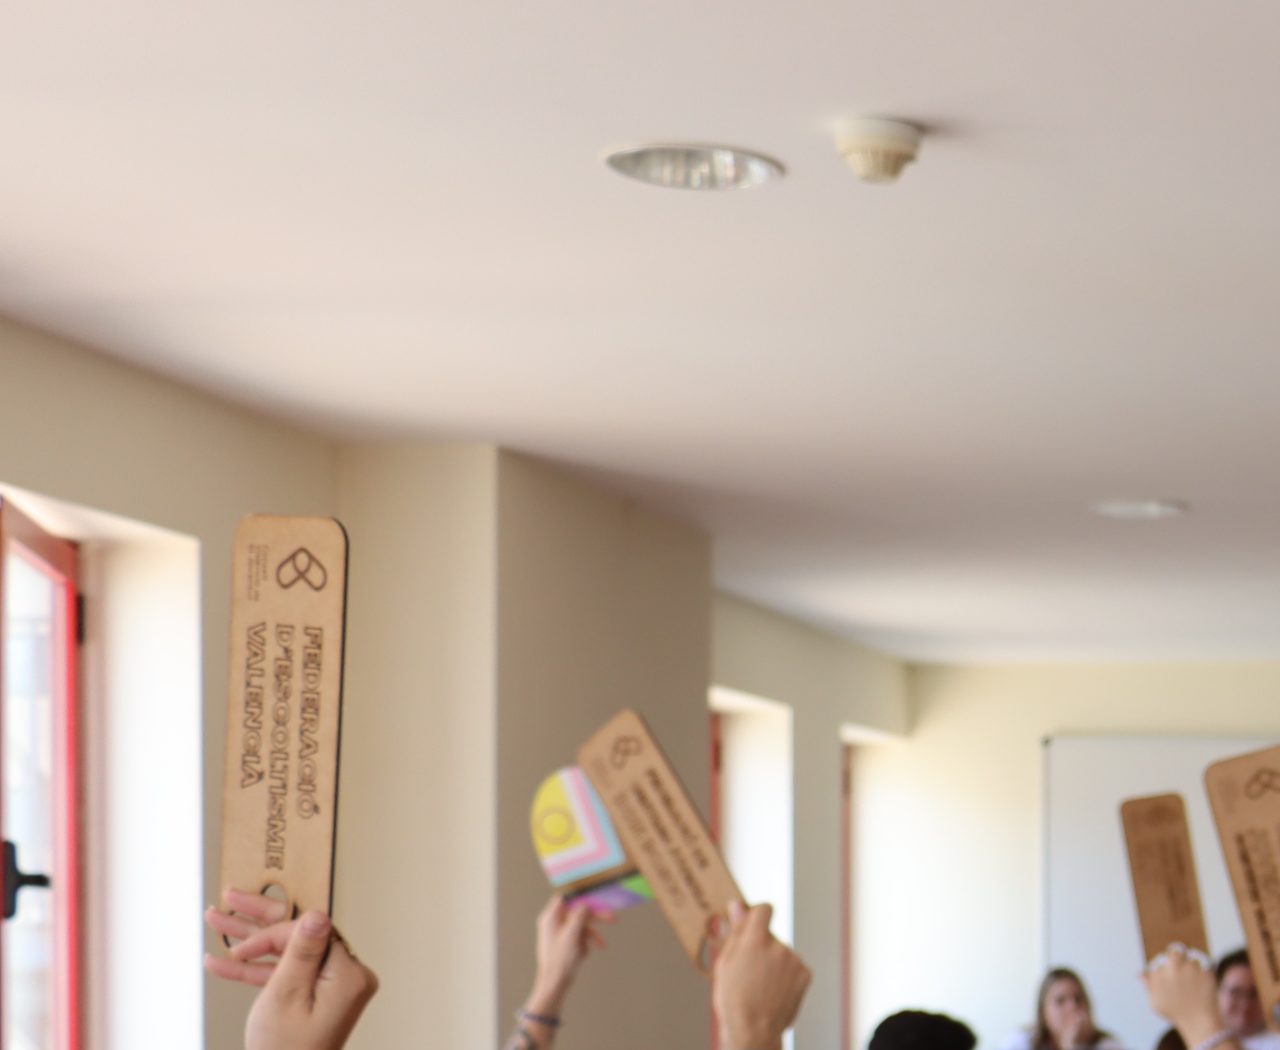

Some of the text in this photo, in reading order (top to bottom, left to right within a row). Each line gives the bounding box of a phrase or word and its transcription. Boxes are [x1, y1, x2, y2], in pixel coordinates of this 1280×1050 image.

[240, 621, 267, 789] VALENCIÀ
[265, 624, 295, 870] D'ESCOLTISME
[298, 626, 323, 819] FEDERACIÓ
